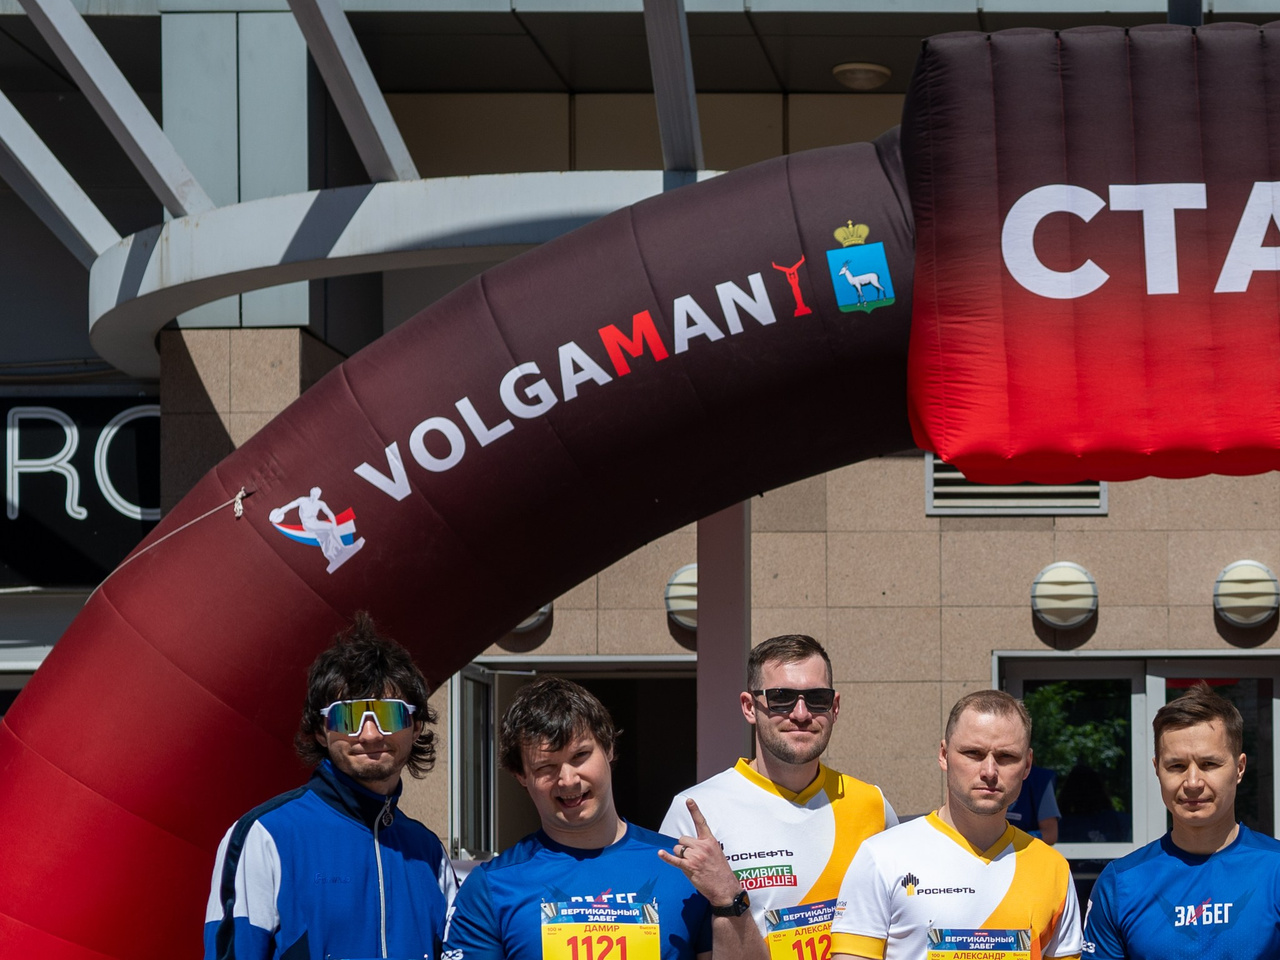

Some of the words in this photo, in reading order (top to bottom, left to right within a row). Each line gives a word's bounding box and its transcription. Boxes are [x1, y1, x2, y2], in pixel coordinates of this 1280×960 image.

[353, 272, 777, 502] VOLGAMAN
[738, 866, 790, 880] ЖИВИТЕ
[917, 887, 975, 895] РОСНЕФТЬ
[560, 908, 640, 917] ВЕРТИКАЛЬНЫЙ
[783, 906, 836, 921] ВЕРТИКАЛЬН
[808, 914, 832, 924] ЗАБЕГ
[584, 925, 620, 933] ДАМИР
[794, 922, 833, 937] АЛЕКСАН
[945, 935, 1014, 943] ВЕРТИКАЛЬНЫЙ
[953, 952, 1006, 960] АЛЕКСАНДР
